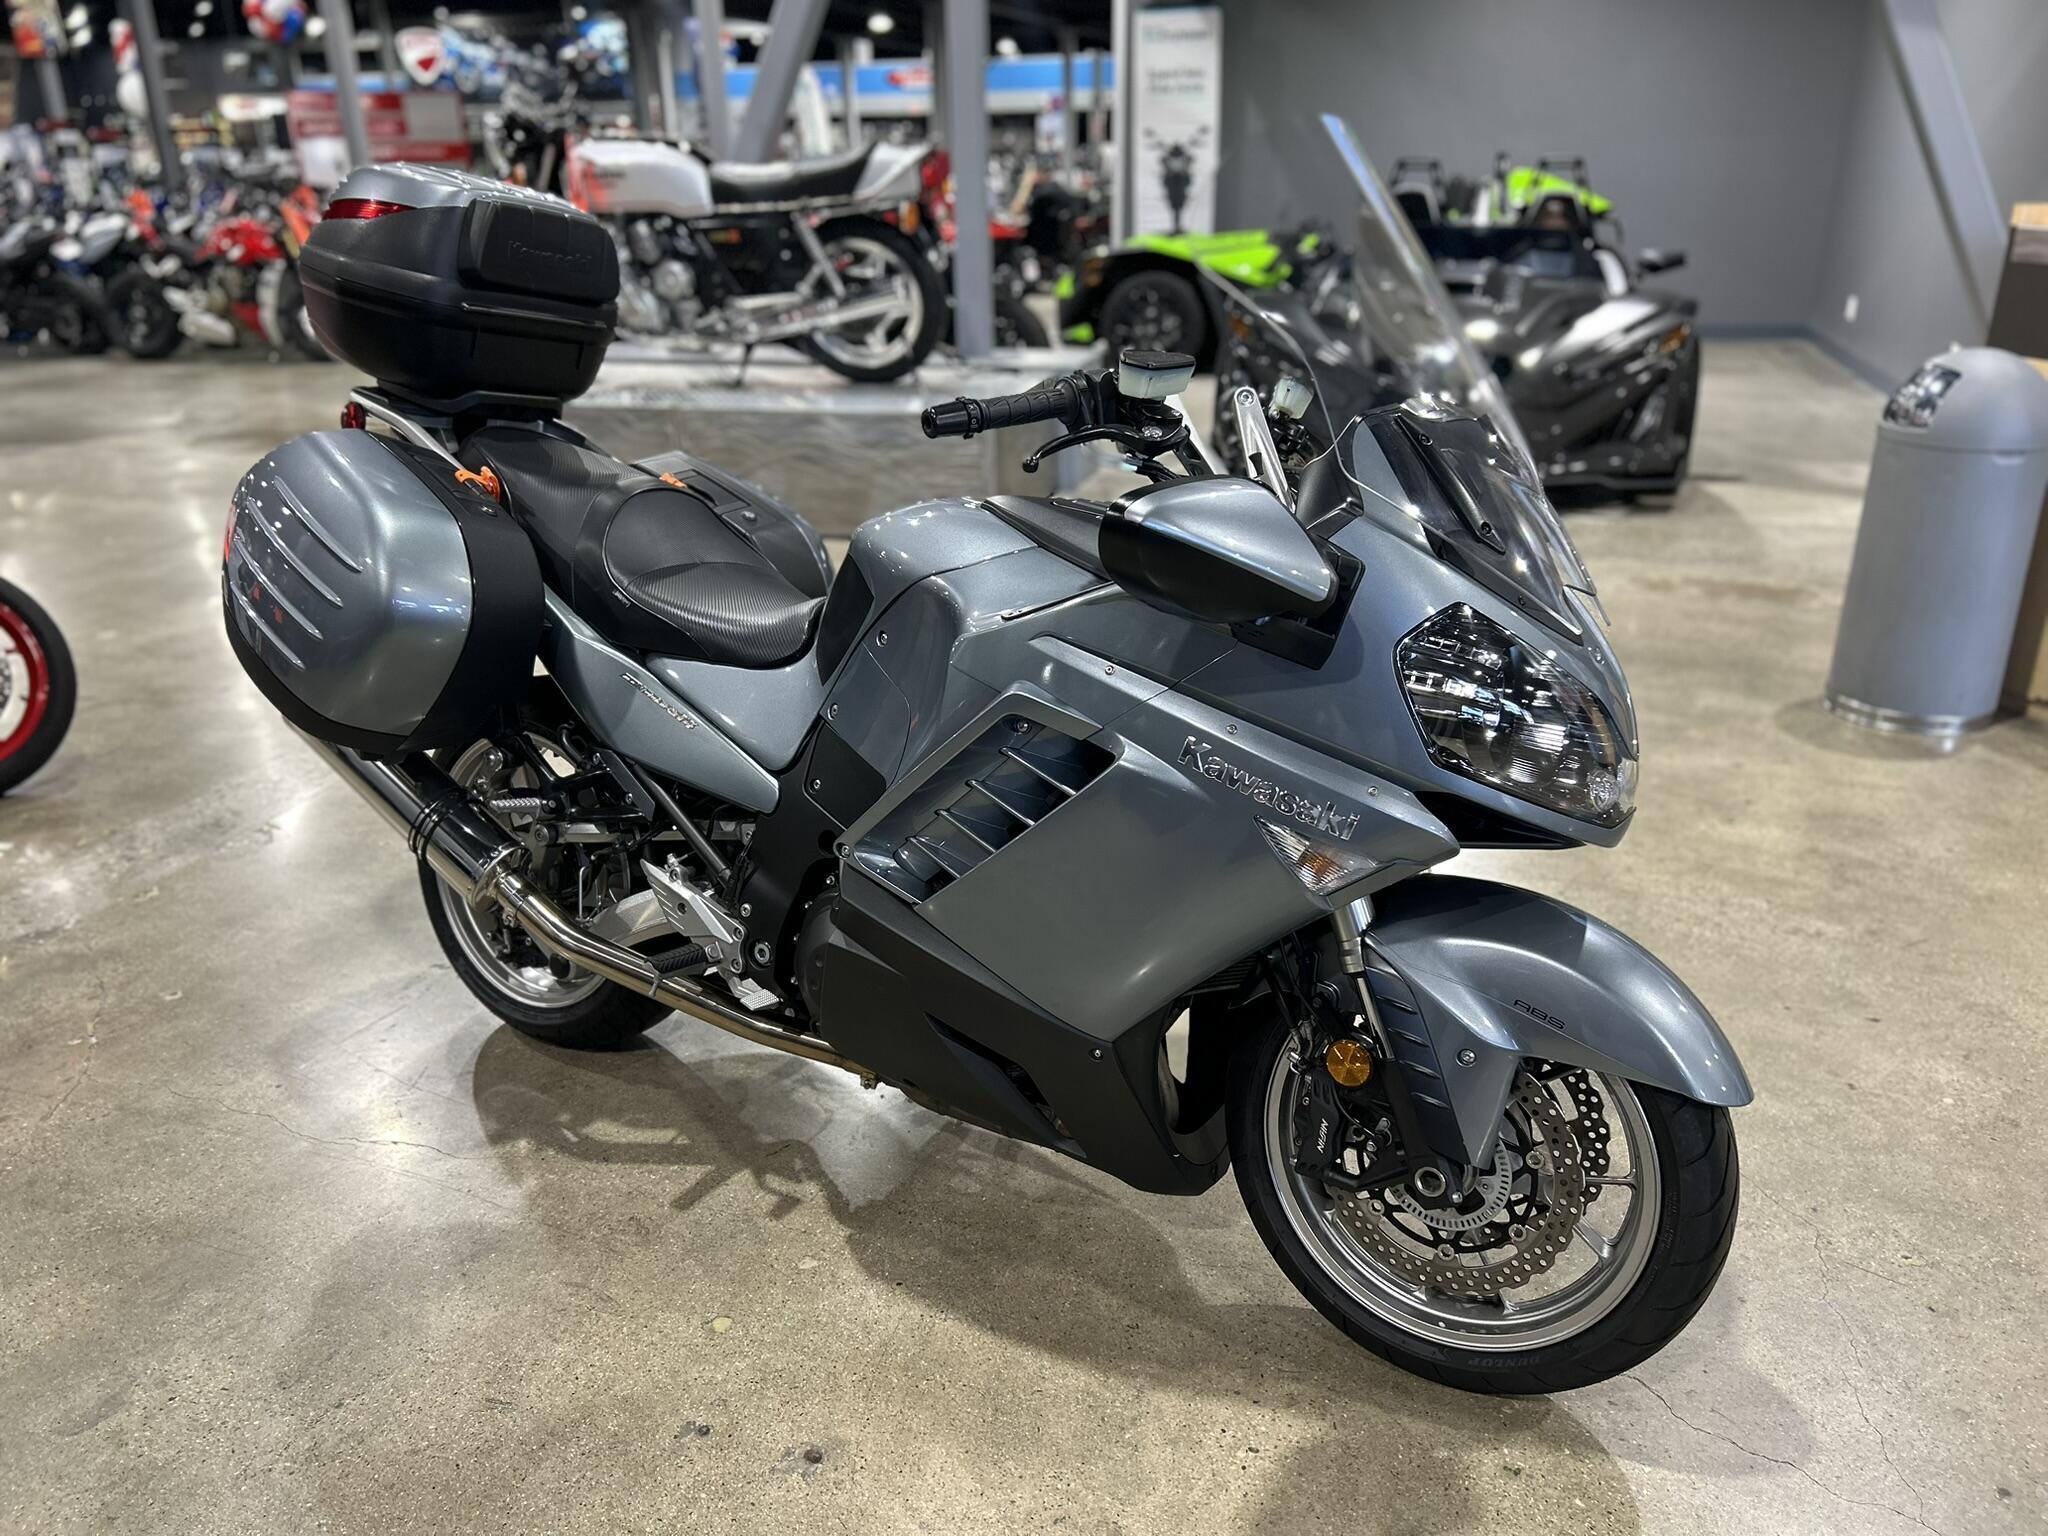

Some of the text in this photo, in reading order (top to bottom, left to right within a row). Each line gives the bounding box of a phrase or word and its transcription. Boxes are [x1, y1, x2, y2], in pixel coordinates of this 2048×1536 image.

[1177, 735, 1360, 840] Kawasaki
[1513, 999, 1566, 1030] ABS
[1468, 1355, 1540, 1367] DUNLOP
